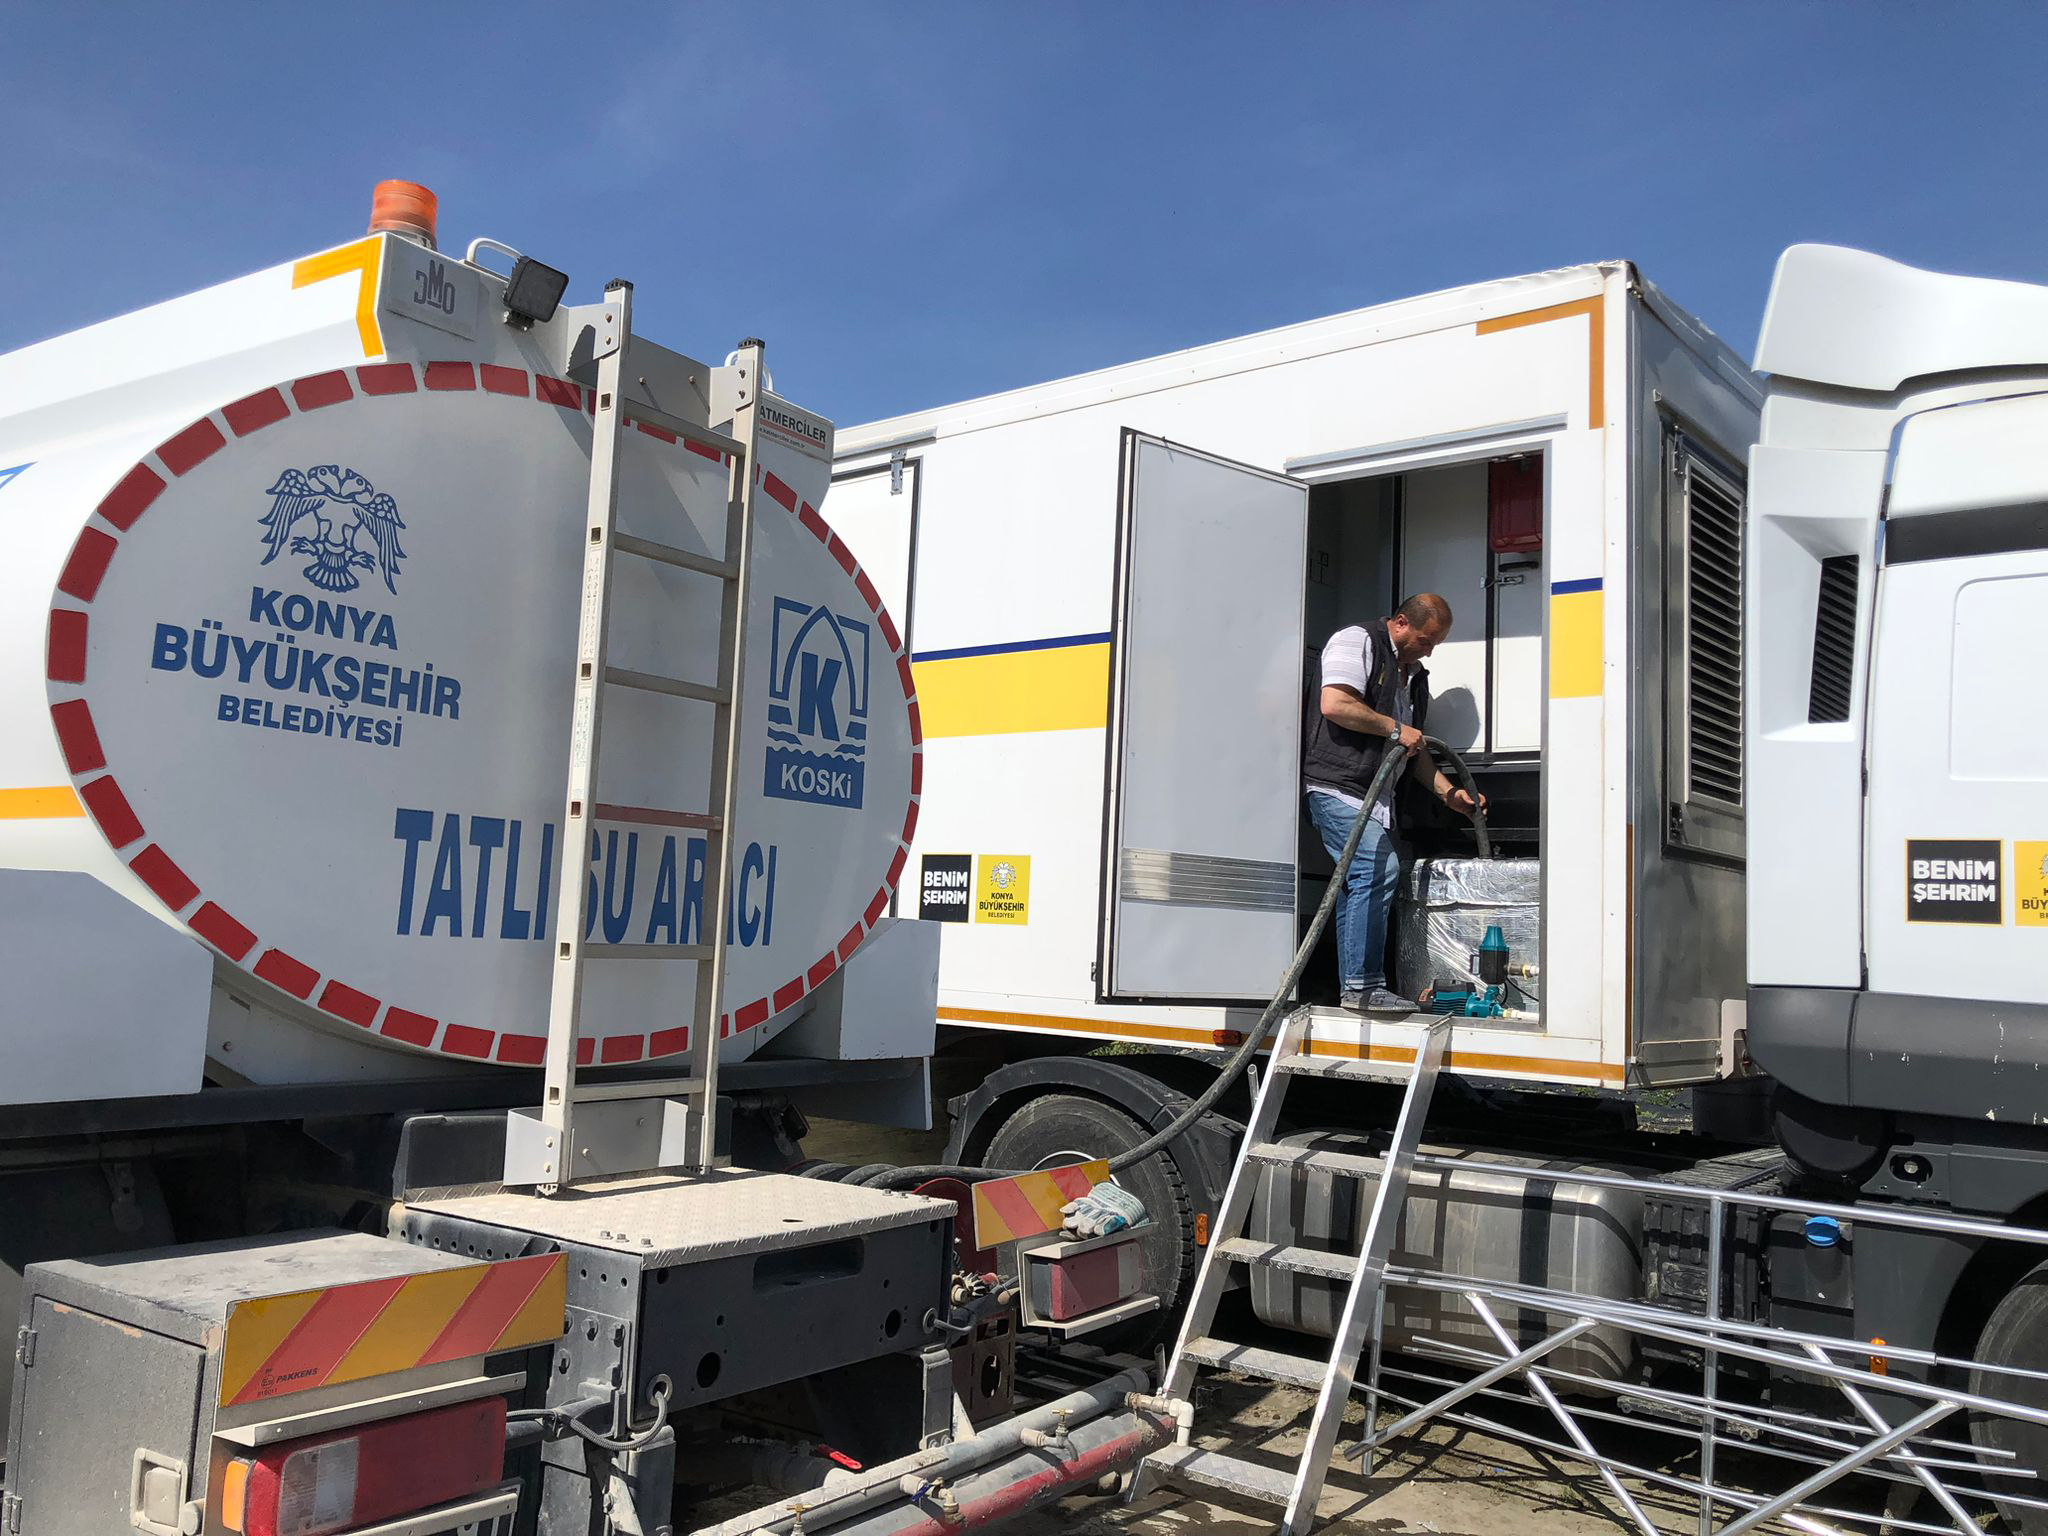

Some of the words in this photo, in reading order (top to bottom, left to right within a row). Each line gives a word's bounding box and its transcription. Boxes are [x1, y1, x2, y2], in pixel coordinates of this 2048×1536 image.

[760, 405, 826, 443] ATMERCİLER
[249, 586, 398, 650] KONYA
[151, 618, 462, 720] BÜYÜKŞEHİR
[217, 694, 403, 748] BELEDİYESİ
[394, 808, 555, 941] TATLI
[645, 835, 777, 947] ARCI
[991, 892, 1014, 900] KONYA
